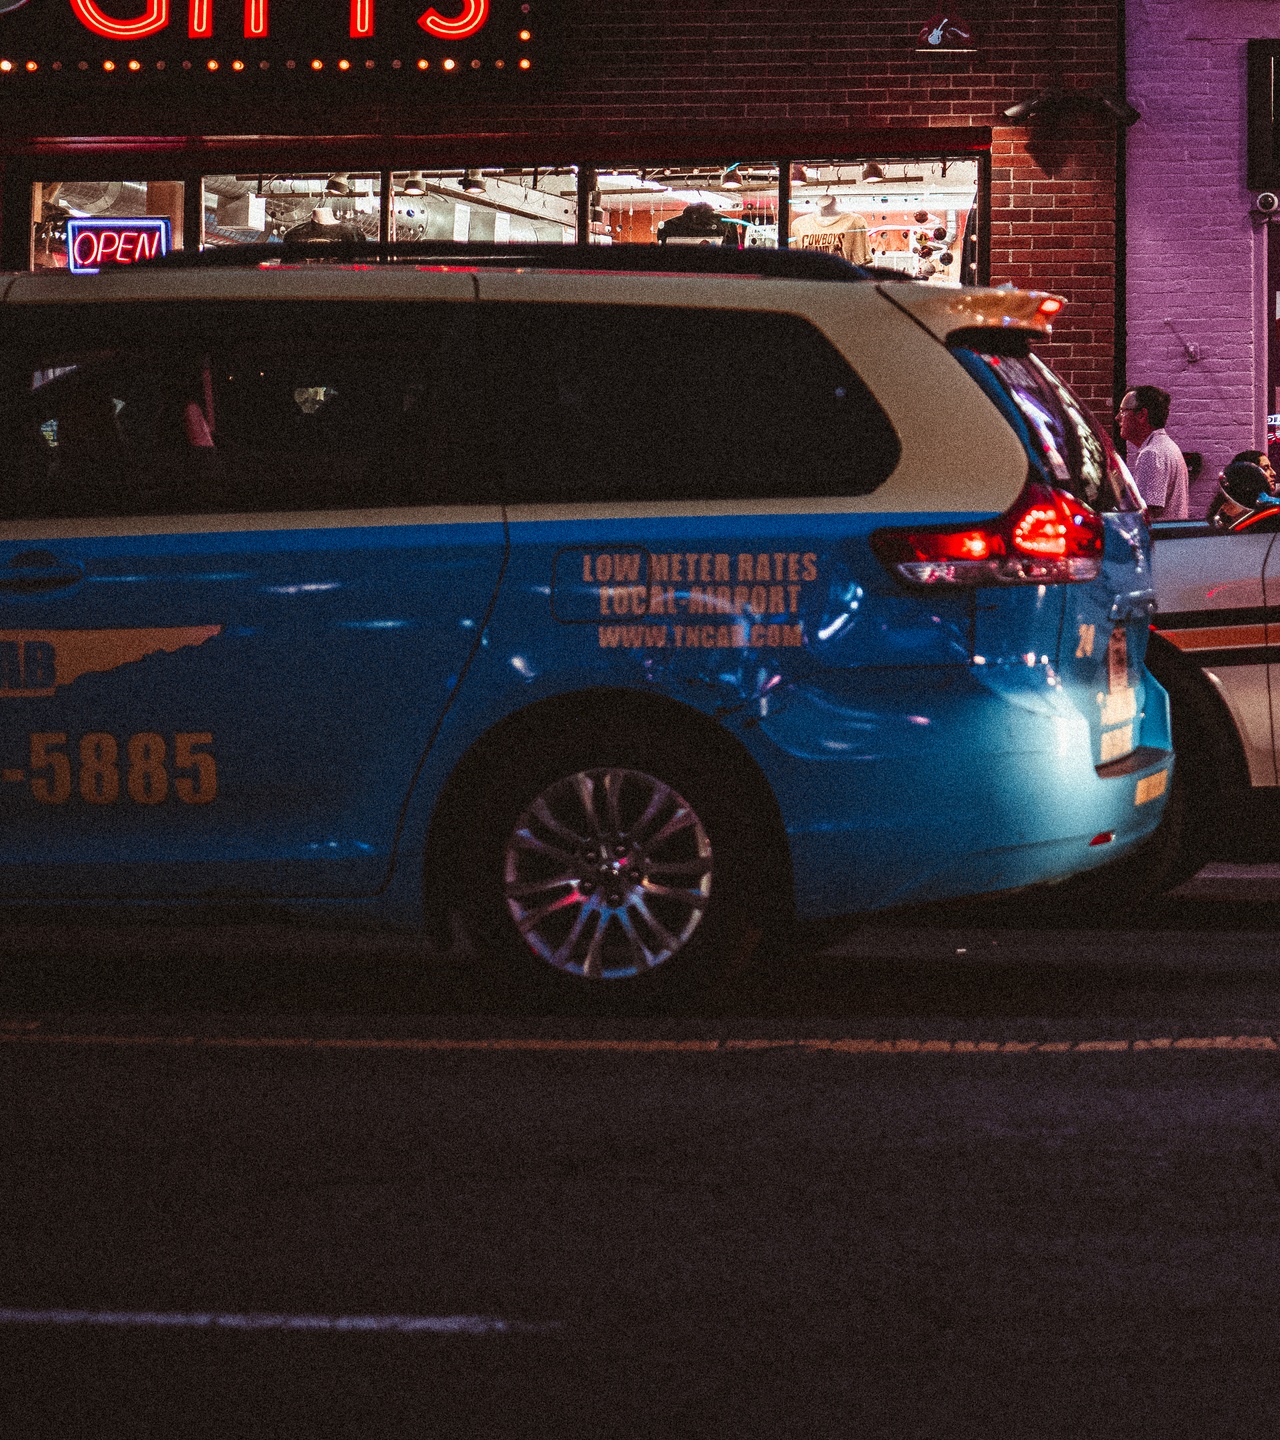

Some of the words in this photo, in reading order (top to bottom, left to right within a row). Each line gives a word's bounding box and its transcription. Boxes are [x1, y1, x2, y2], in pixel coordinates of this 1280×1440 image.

[73, 231, 160, 265] OPEN
[802, 232, 846, 252] COWBOYS
[583, 554, 640, 582] LOW
[650, 553, 731, 582] METER
[737, 552, 818, 581] RATES
